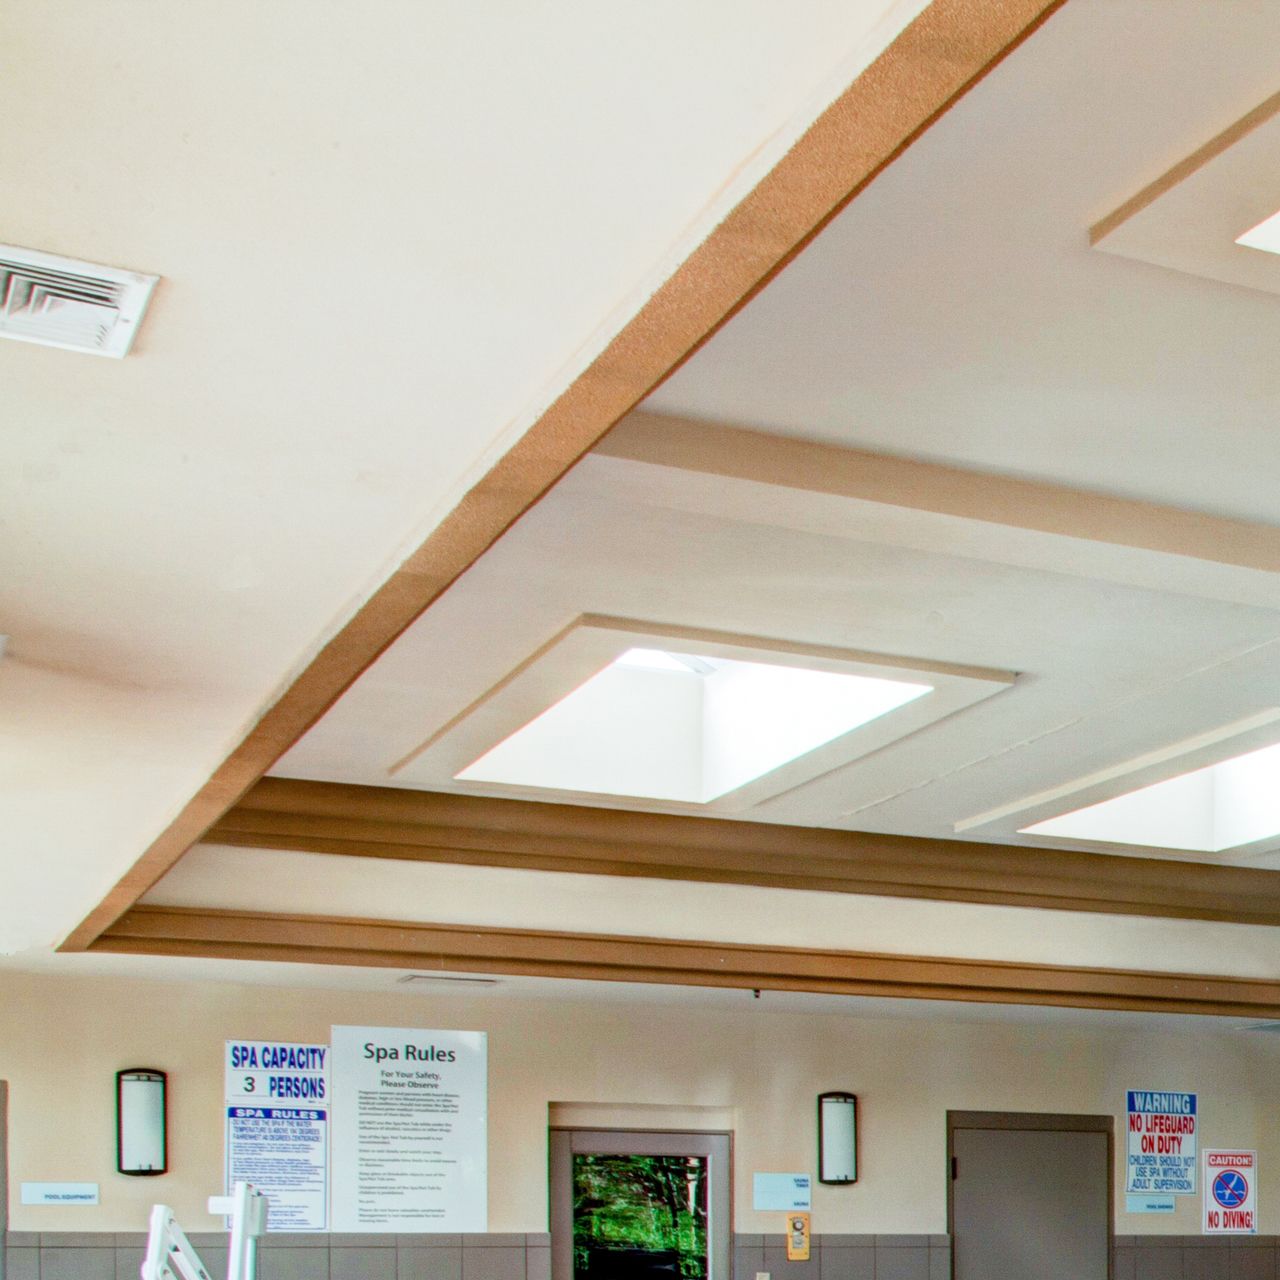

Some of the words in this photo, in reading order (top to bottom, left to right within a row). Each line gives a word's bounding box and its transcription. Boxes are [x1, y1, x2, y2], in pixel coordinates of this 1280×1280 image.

[232, 1046, 258, 1068] SPA
[262, 1046, 325, 1069] CAPACITY
[364, 1043, 399, 1063] Spa
[406, 1045, 455, 1062] Rules
[244, 1077, 255, 1092] 3
[270, 1076, 325, 1098] PERSONS
[1134, 1093, 1190, 1113] WARNING
[236, 1109, 264, 1117] SPA
[271, 1110, 318, 1119] RULES
[1129, 1114, 1142, 1132] NO
[1146, 1115, 1194, 1134] LIFEGUARD
[1141, 1135, 1154, 1153] ON
[1158, 1136, 1182, 1154] DUTY
[1129, 1155, 1157, 1165] CHILDREN
[1159, 1156, 1181, 1166] SHOULD
[1184, 1157, 1195, 1167] NOT
[1136, 1167, 1147, 1177] USE
[1149, 1167, 1160, 1177] SPA
[1162, 1168, 1188, 1178] WITHOUT
[1132, 1179, 1150, 1189] ADULT
[1154, 1180, 1192, 1190] SUPERVISION
[1208, 1211, 1219, 1228] NO
[1223, 1211, 1253, 1228] DIVING!
